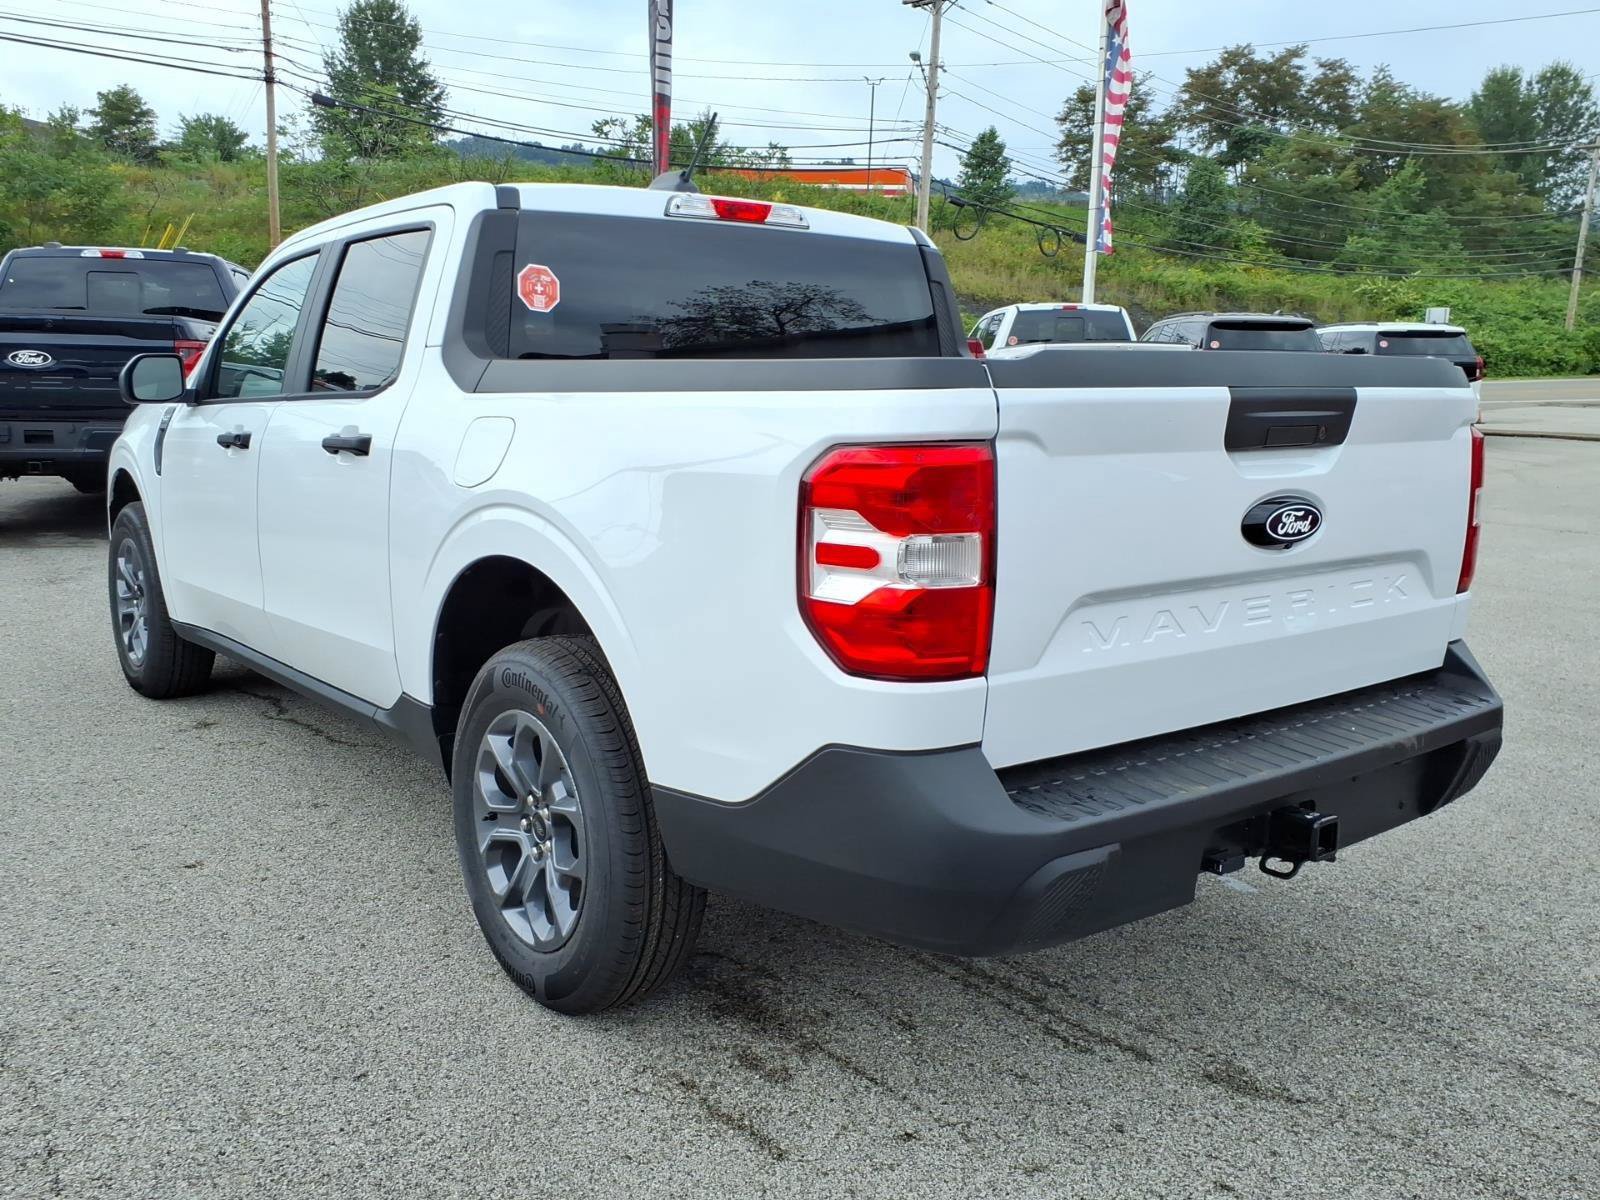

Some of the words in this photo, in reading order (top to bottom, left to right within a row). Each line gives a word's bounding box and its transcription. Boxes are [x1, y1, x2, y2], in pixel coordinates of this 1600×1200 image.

[16, 352, 44, 364] Ford
[1277, 510, 1312, 535] Ford
[1081, 574, 1408, 653] MAVERICK
[501, 667, 559, 719] Continental
